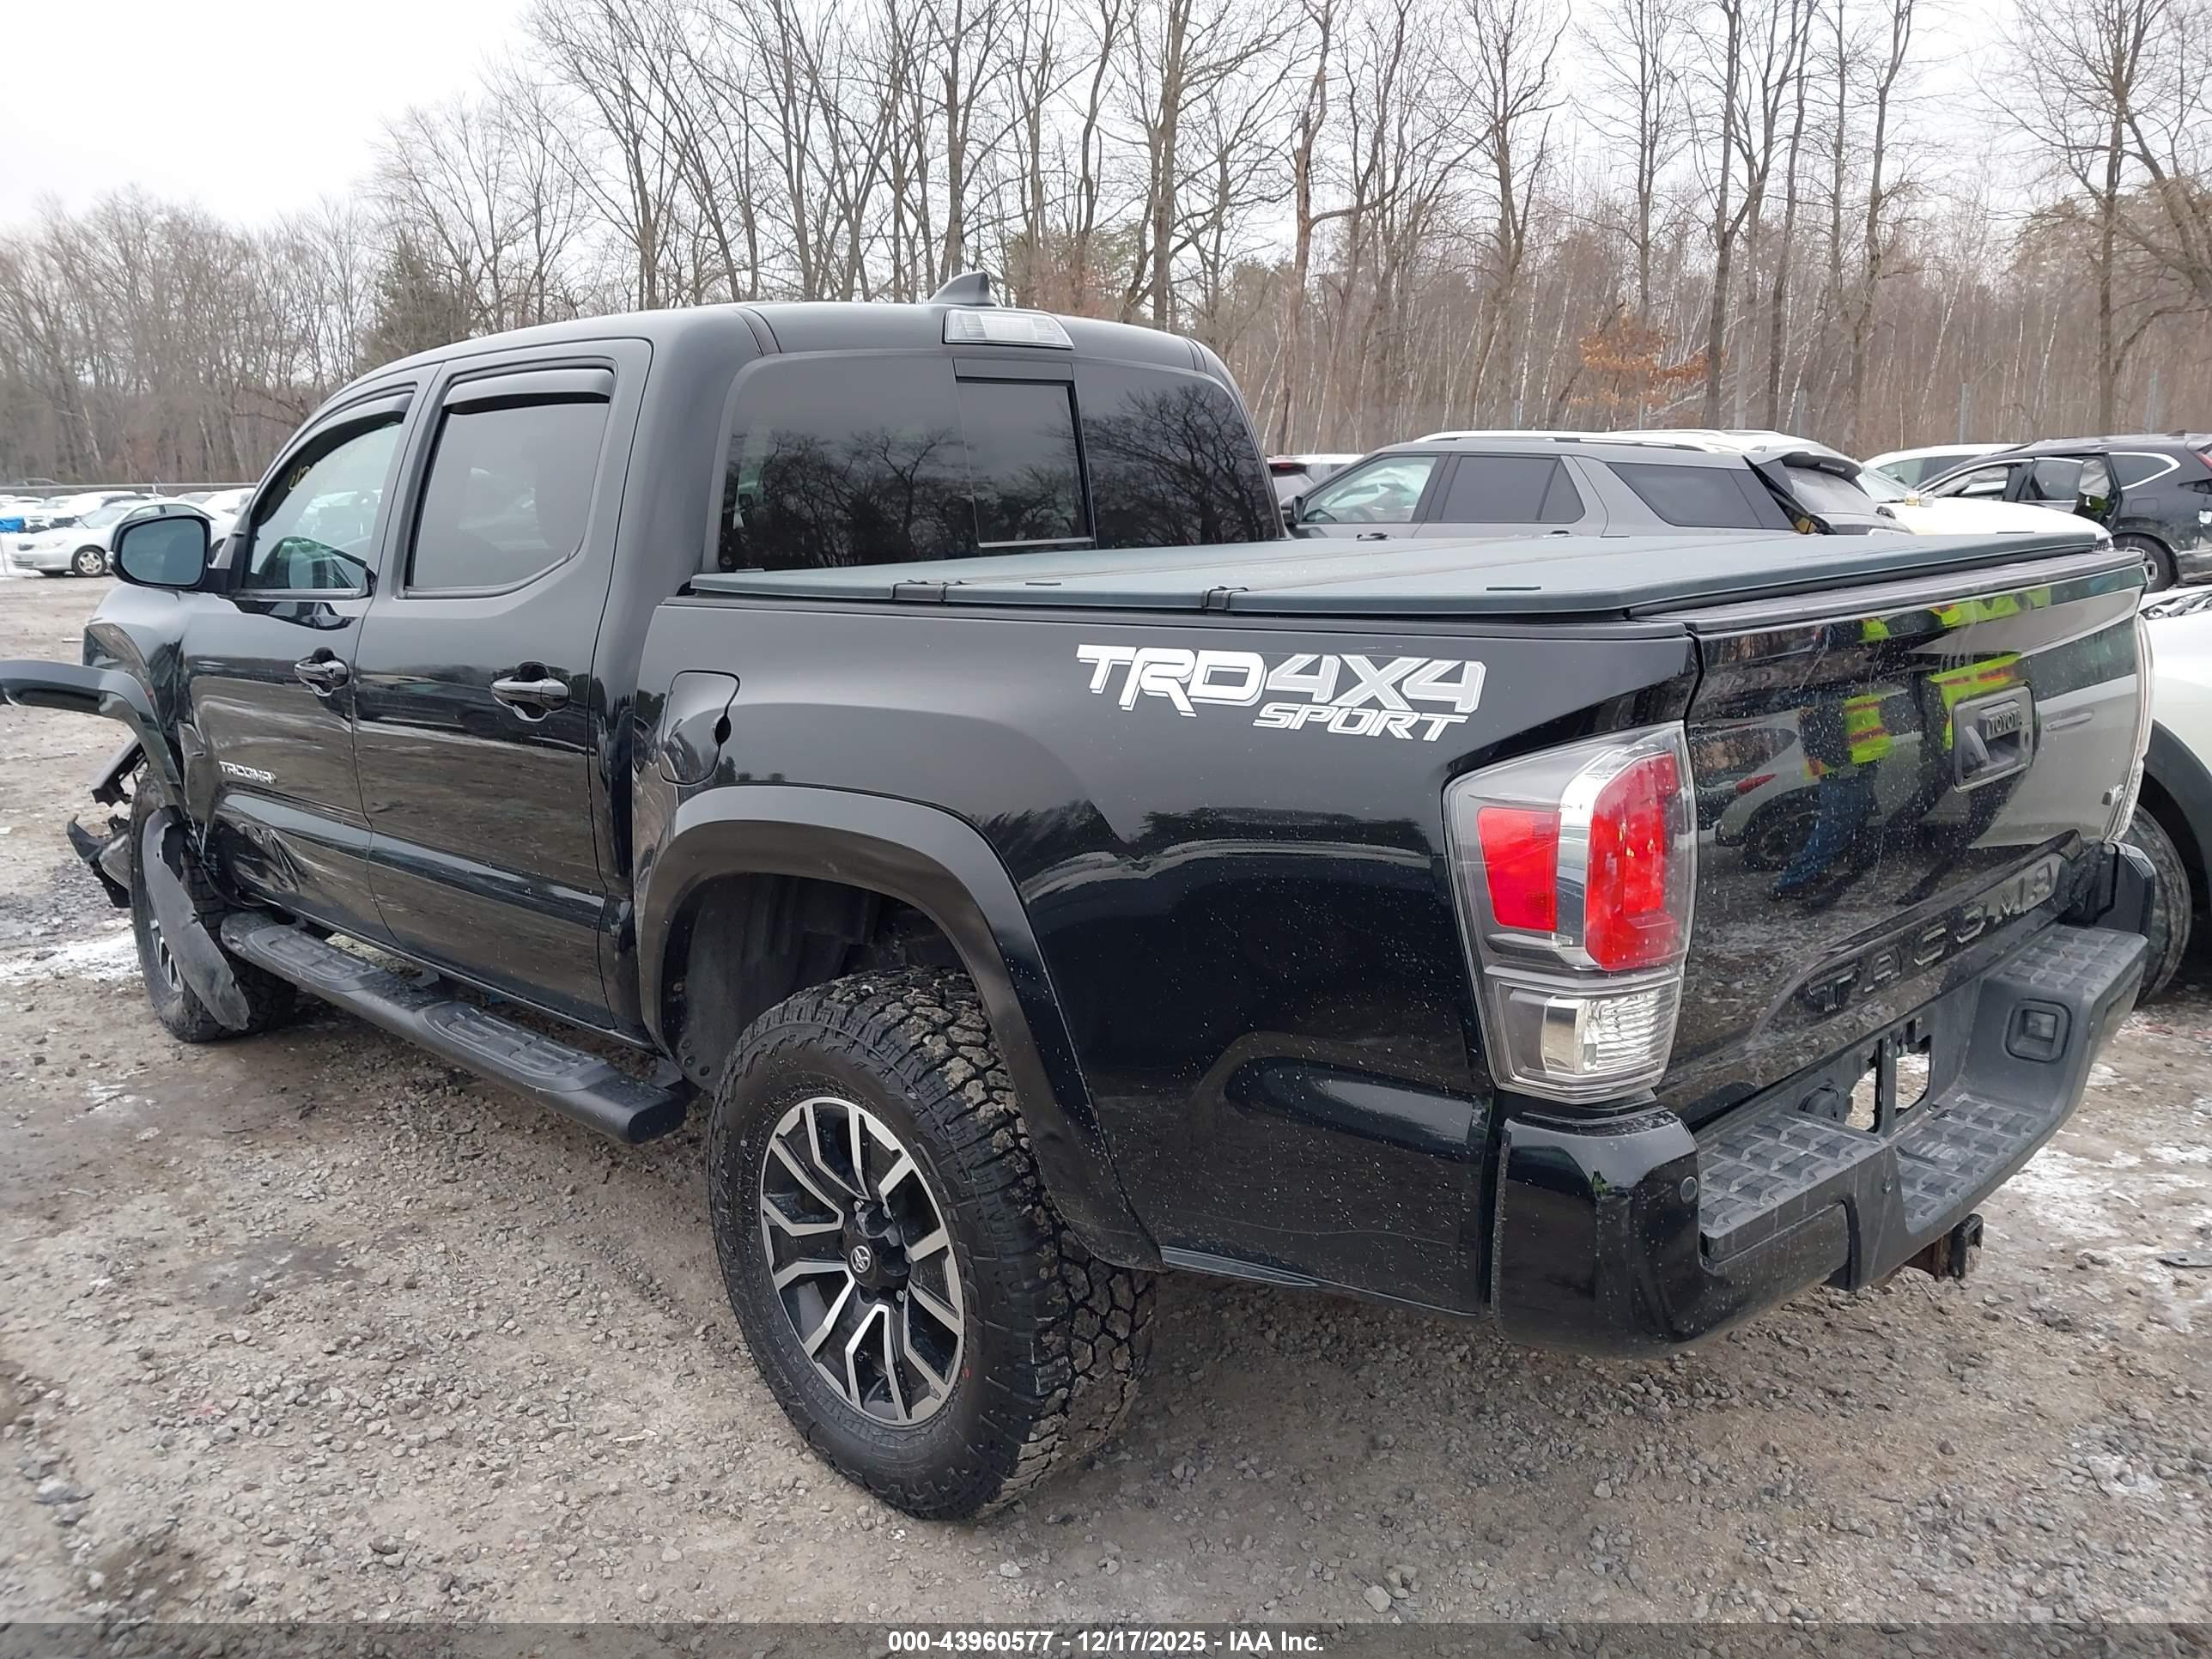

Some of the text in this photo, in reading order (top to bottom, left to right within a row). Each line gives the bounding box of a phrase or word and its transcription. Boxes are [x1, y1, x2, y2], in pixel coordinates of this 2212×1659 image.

[1076, 644, 1267, 717] TRD
[1253, 702, 1468, 742] SPORT
[218, 761, 276, 784] TACOMA
[1807, 861, 2055, 1012] TACOMA
